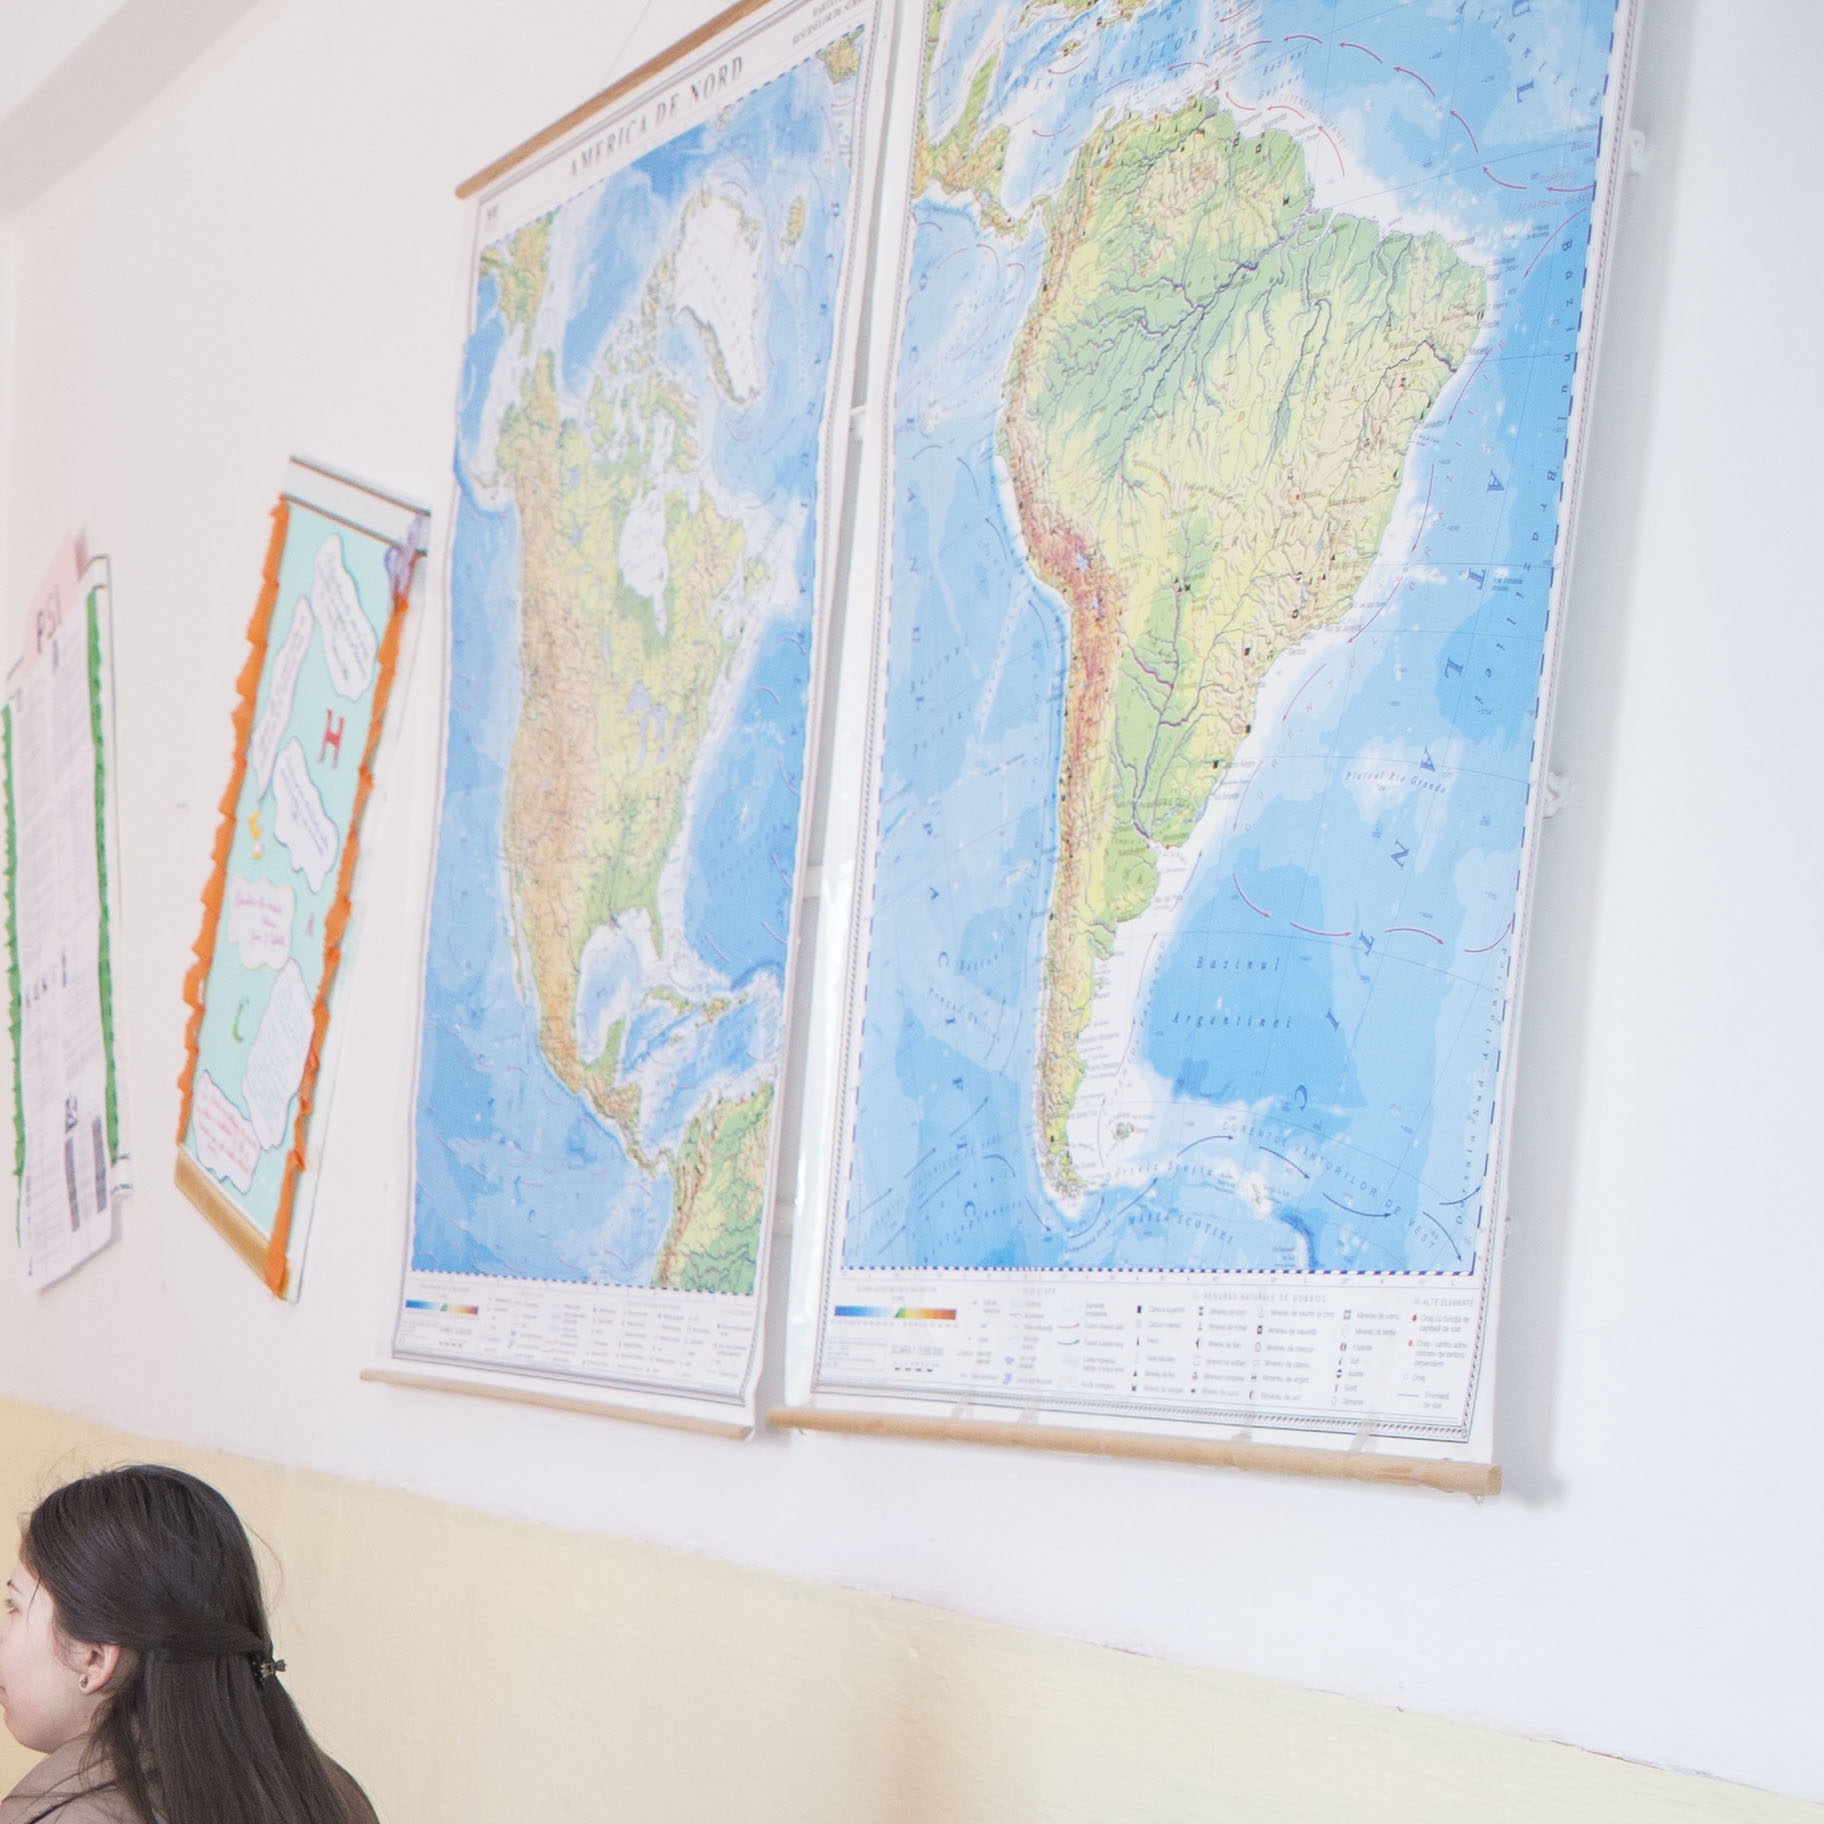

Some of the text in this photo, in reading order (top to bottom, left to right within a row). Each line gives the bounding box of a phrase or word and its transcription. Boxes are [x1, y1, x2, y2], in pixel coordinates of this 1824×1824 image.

[569, 54, 743, 177] AMERICA DE NORD
[1195, 955, 1282, 971] Bazinul
[1171, 1010, 1293, 1030] Argentinei
